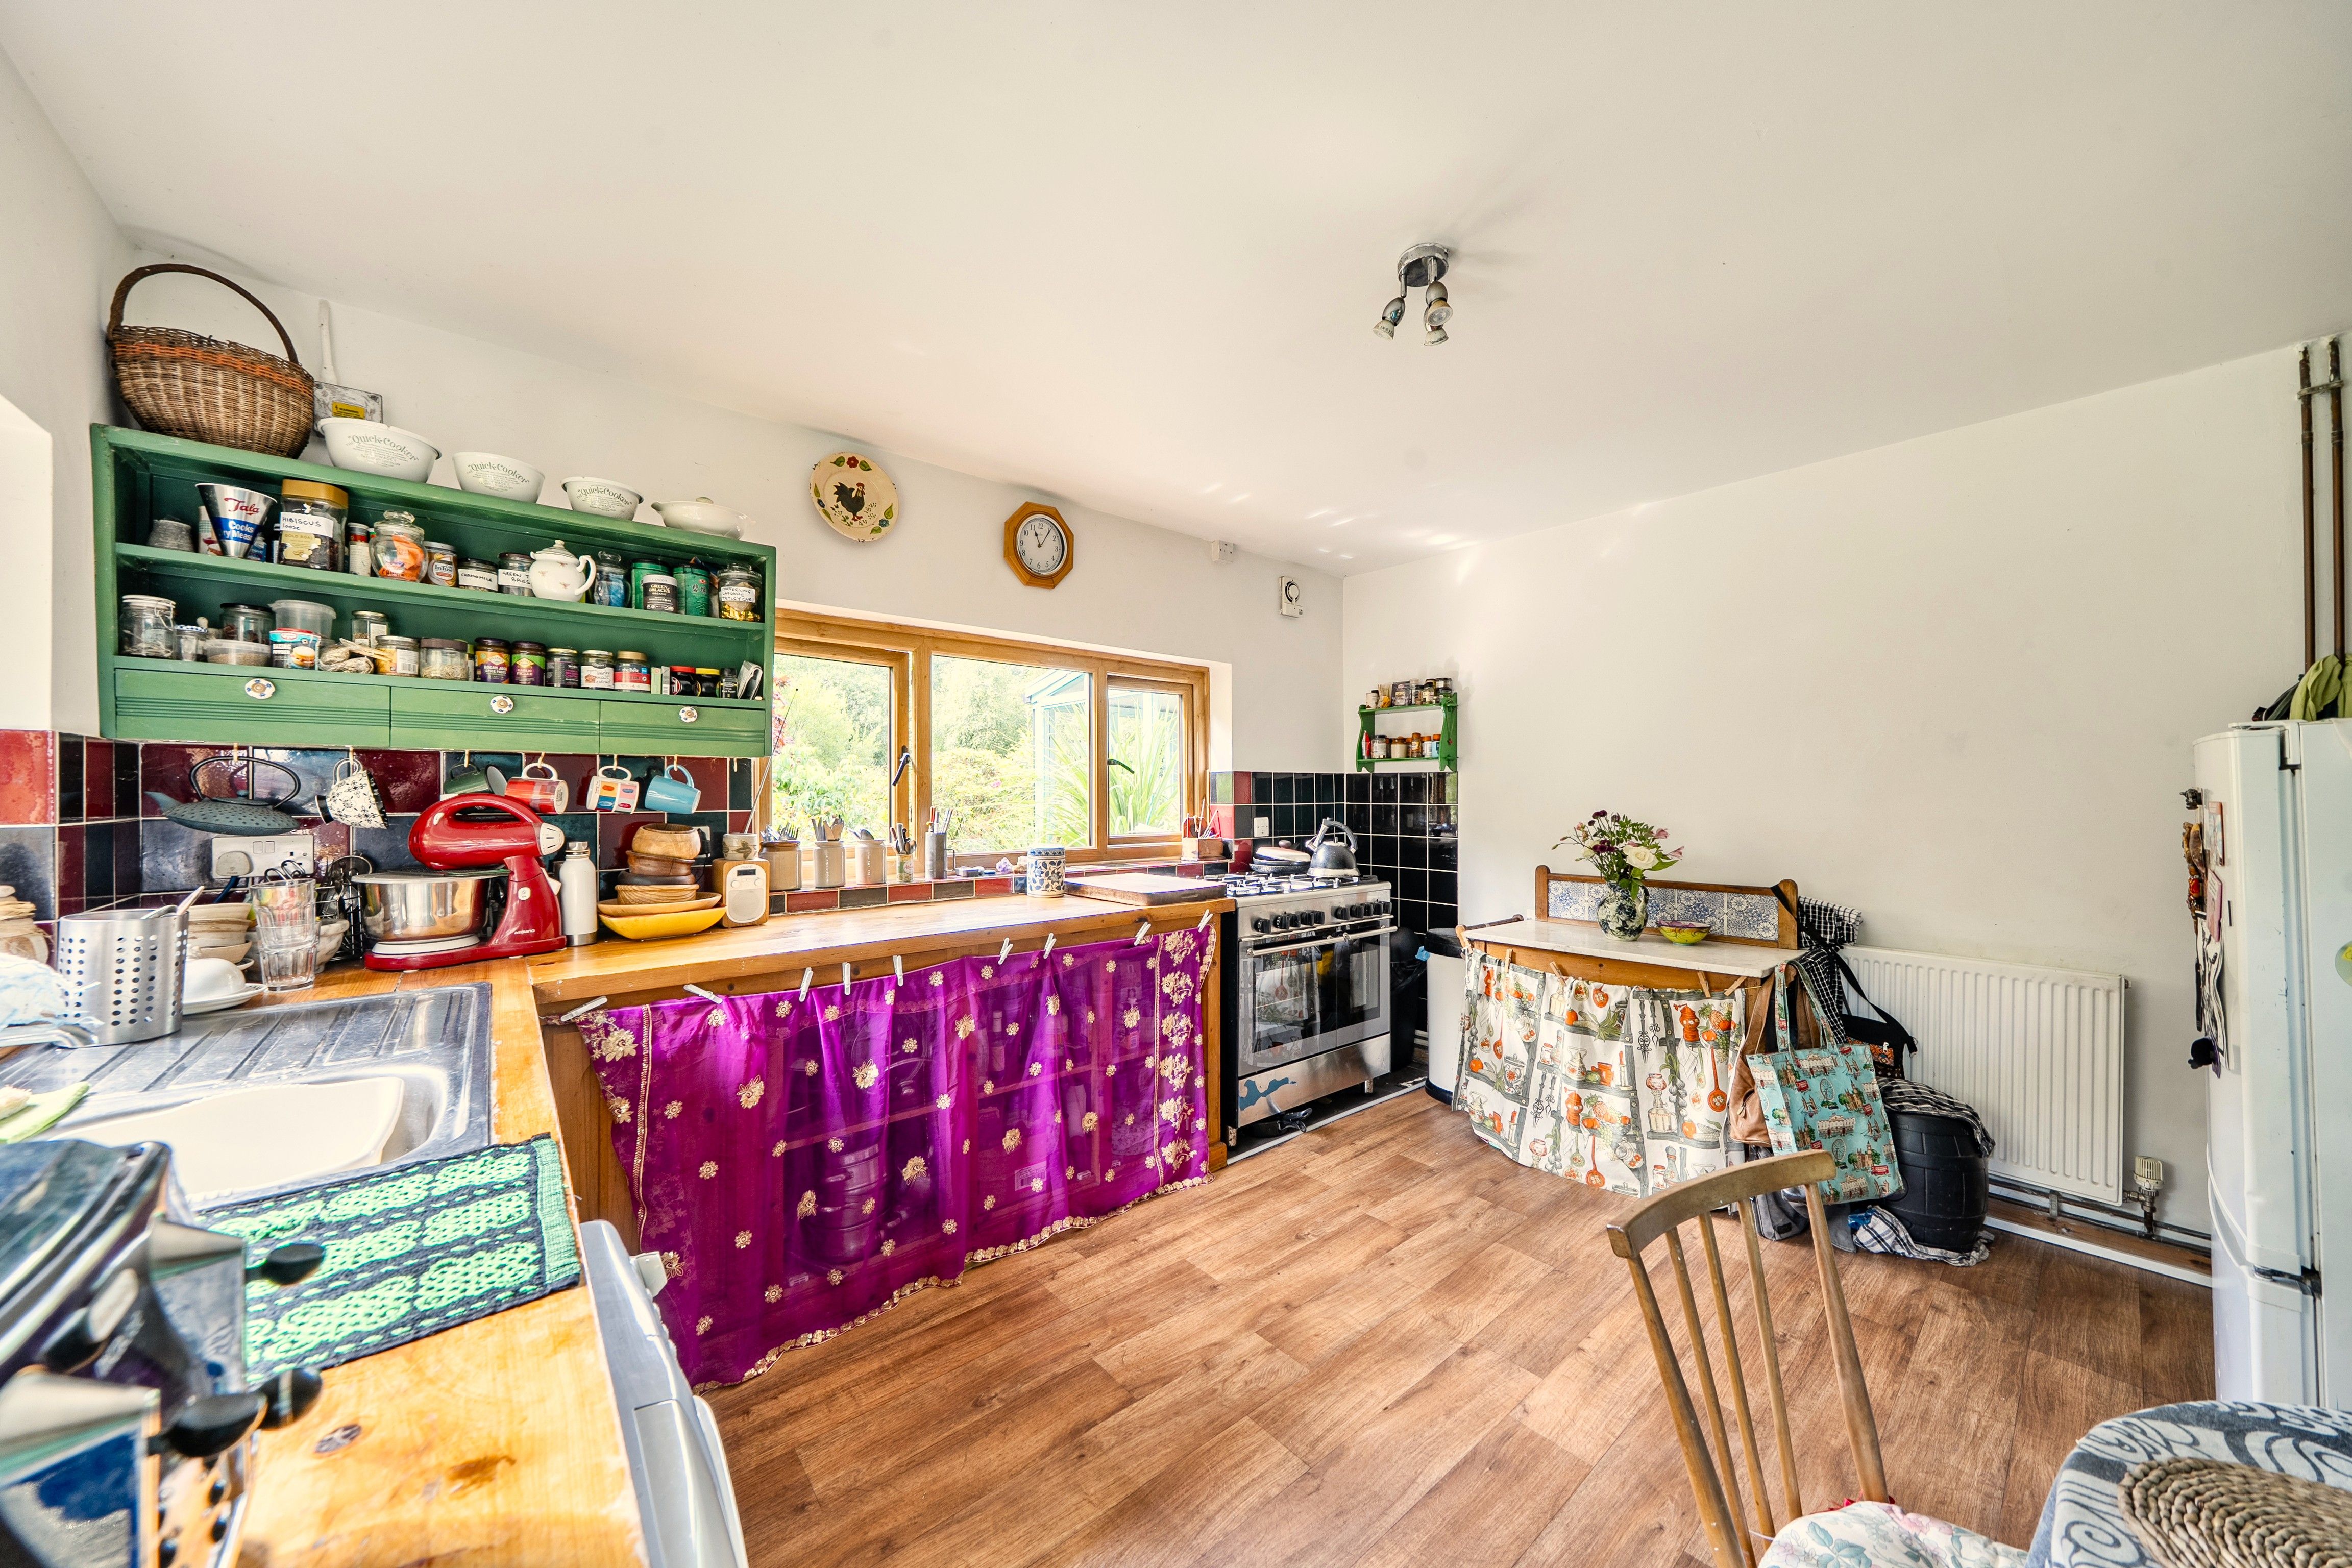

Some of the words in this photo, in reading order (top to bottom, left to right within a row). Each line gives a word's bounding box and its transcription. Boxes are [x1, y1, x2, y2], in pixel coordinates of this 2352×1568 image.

[224, 497, 260, 516] Tala
[228, 520, 254, 533] Cooks
[282, 516, 322, 527] HIBISCUS
[460, 573, 493, 582] CHAMOMILE
[511, 577, 530, 585] BAGS
